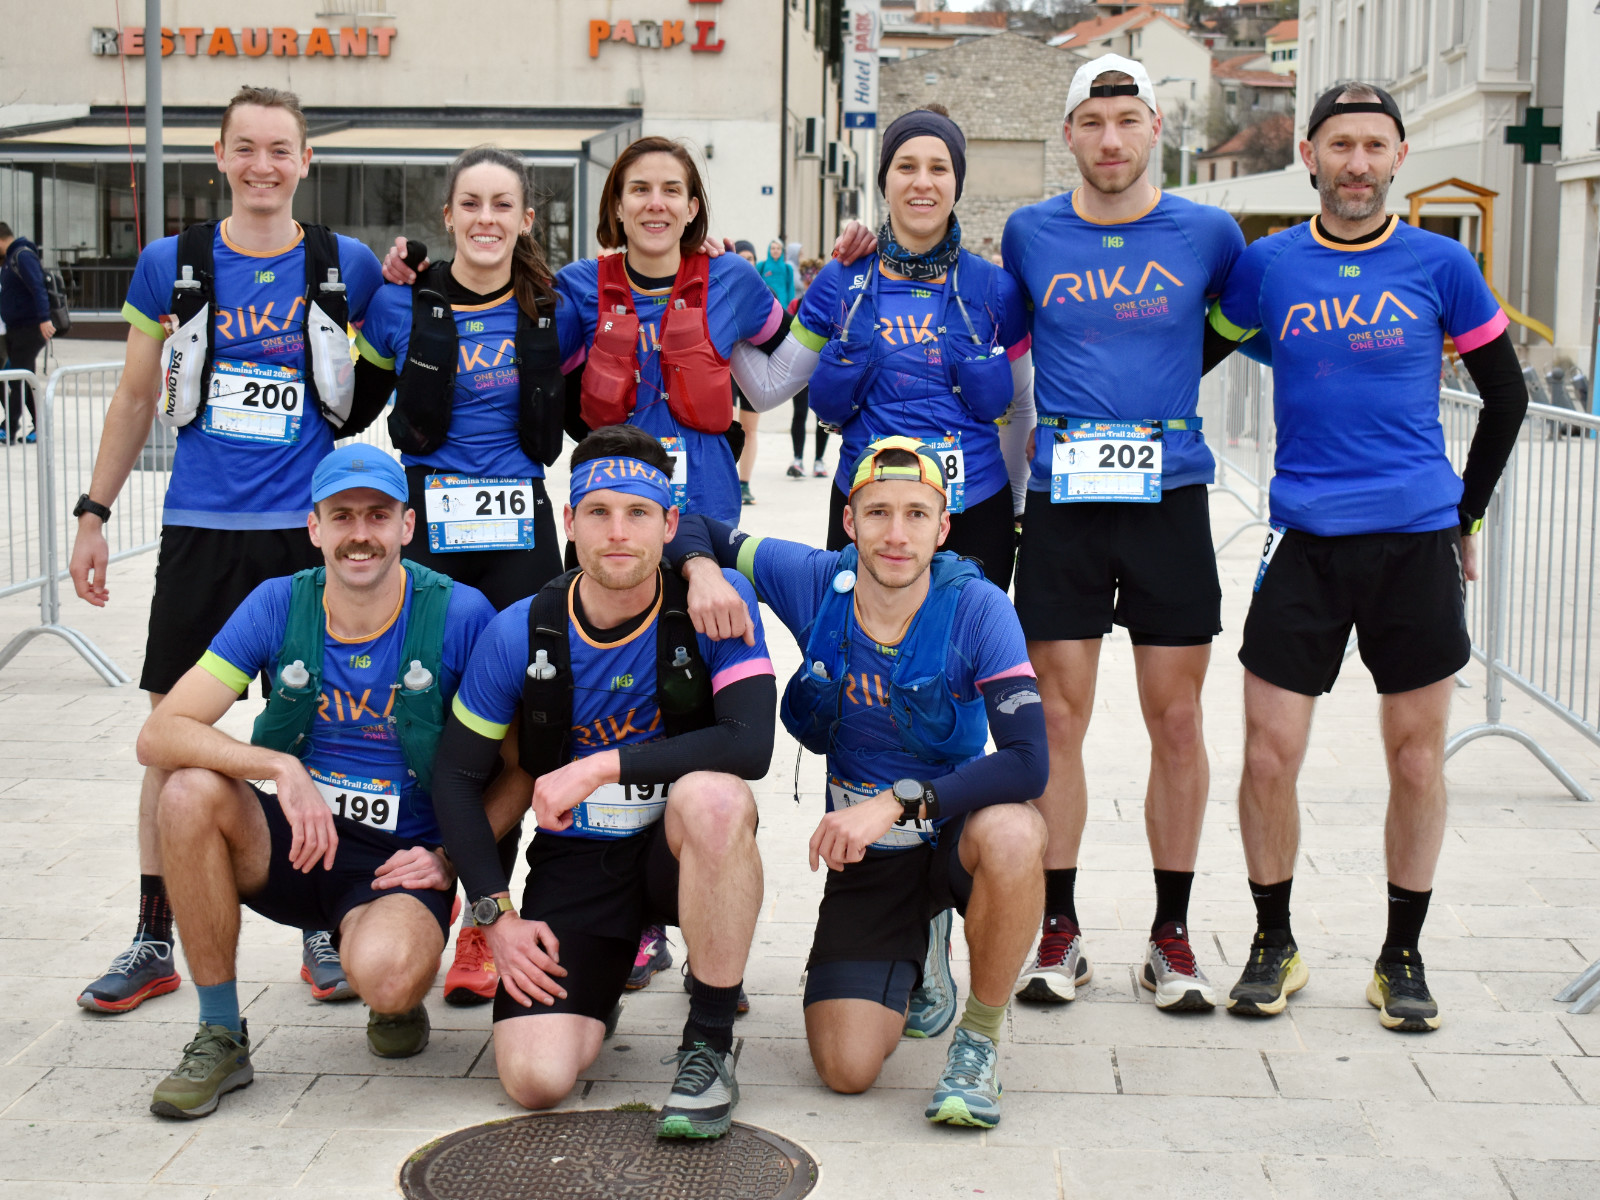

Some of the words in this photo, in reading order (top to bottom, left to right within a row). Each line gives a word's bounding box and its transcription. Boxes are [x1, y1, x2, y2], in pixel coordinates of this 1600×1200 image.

[91, 27, 397, 57] RESTAURANT
[589, 20, 684, 58] PARK
[855, 13, 877, 53] PARK
[853, 59, 871, 105] Hotel
[1042, 260, 1184, 307] RIKA
[1114, 301, 1137, 311] ONE
[1139, 296, 1168, 307] CLUB
[1116, 310, 1138, 320] ONE
[1141, 305, 1169, 316] LOVE
[1279, 291, 1419, 340] RIKA
[261, 337, 284, 347] ONE
[286, 335, 304, 344] CLU
[1348, 332, 1373, 342] ONE
[1374, 328, 1403, 338] CLUB
[1350, 341, 1374, 351] ONE
[1377, 337, 1405, 347] LOVE
[286, 344, 306, 353] LOV
[166, 350, 183, 417] SALOMON
[219, 365, 254, 375] Promina
[254, 368, 272, 377] Trail
[273, 370, 291, 379] 2025
[474, 372, 494, 382] ONE
[475, 380, 495, 390] ONE
[497, 377, 519, 386] LOVE
[243, 382, 297, 411] 200
[1074, 431, 1106, 439] Promina
[1126, 431, 1145, 439] 2025
[946, 455, 957, 479] 8
[1098, 444, 1154, 469] 202
[447, 478, 480, 486] Promina
[475, 490, 526, 516] 216
[1263, 533, 1274, 557] 8
[310, 770, 343, 785] Promina
[343, 777, 362, 789] Trail
[363, 781, 383, 792] 2025
[842, 782, 873, 795] Promina
[335, 793, 390, 825] 199
